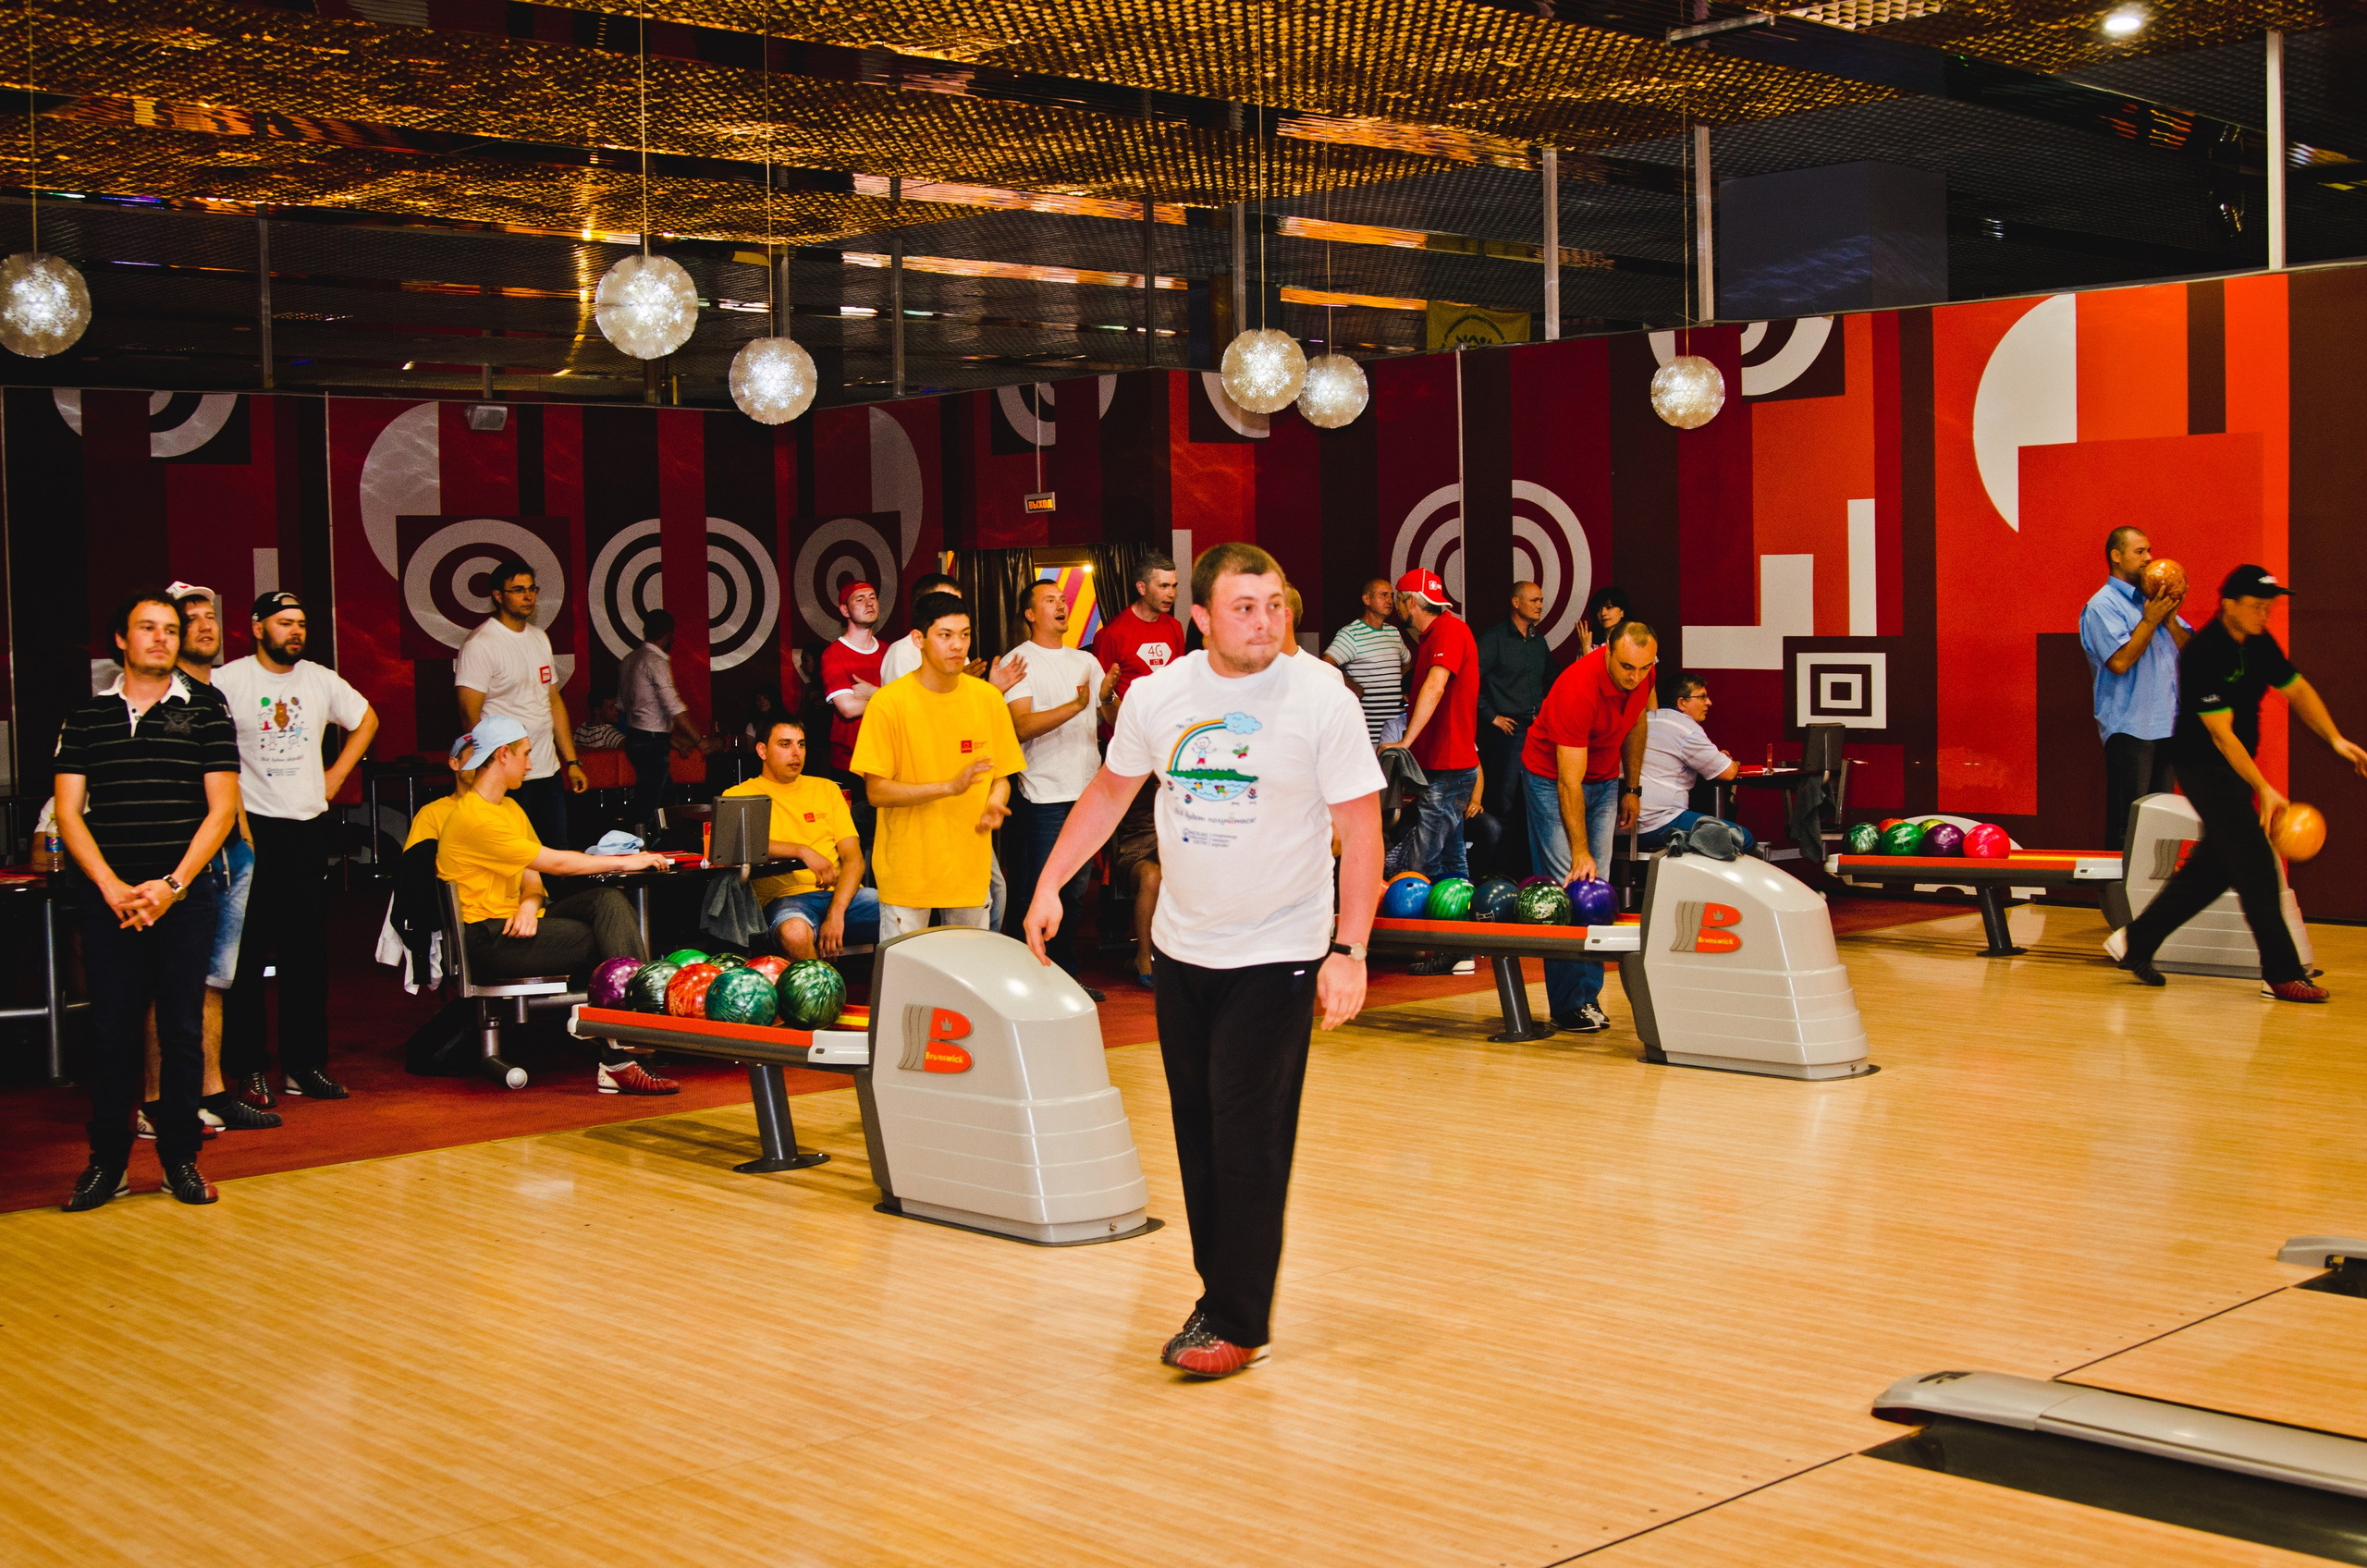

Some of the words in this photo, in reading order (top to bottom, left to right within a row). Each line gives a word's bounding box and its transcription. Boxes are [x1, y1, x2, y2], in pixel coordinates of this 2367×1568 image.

[1028, 499, 1052, 509] ВЫХОД
[1148, 644, 1163, 657] 4G
[1698, 936, 1734, 945] Brunswick
[925, 1051, 963, 1064] Brunswick
